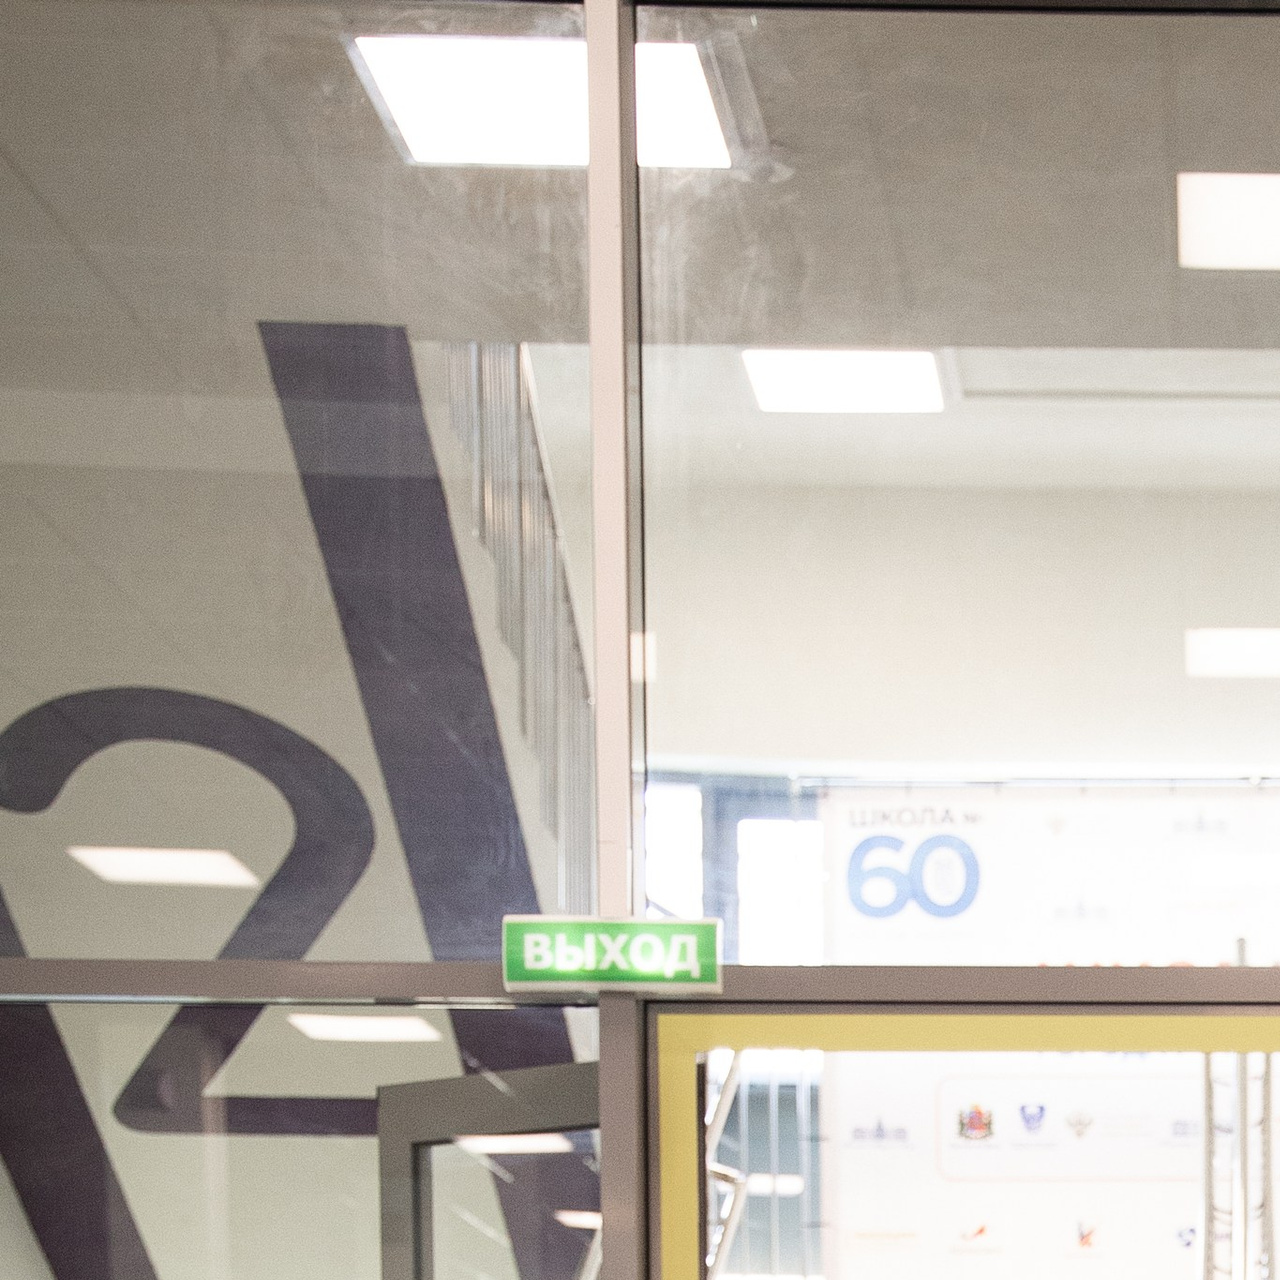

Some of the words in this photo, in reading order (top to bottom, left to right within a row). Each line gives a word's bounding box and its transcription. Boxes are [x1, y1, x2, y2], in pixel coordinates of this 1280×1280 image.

[849, 808, 956, 828] ШКОЛА
[846, 833, 982, 918] 60
[523, 932, 700, 979] ВЫХОД
